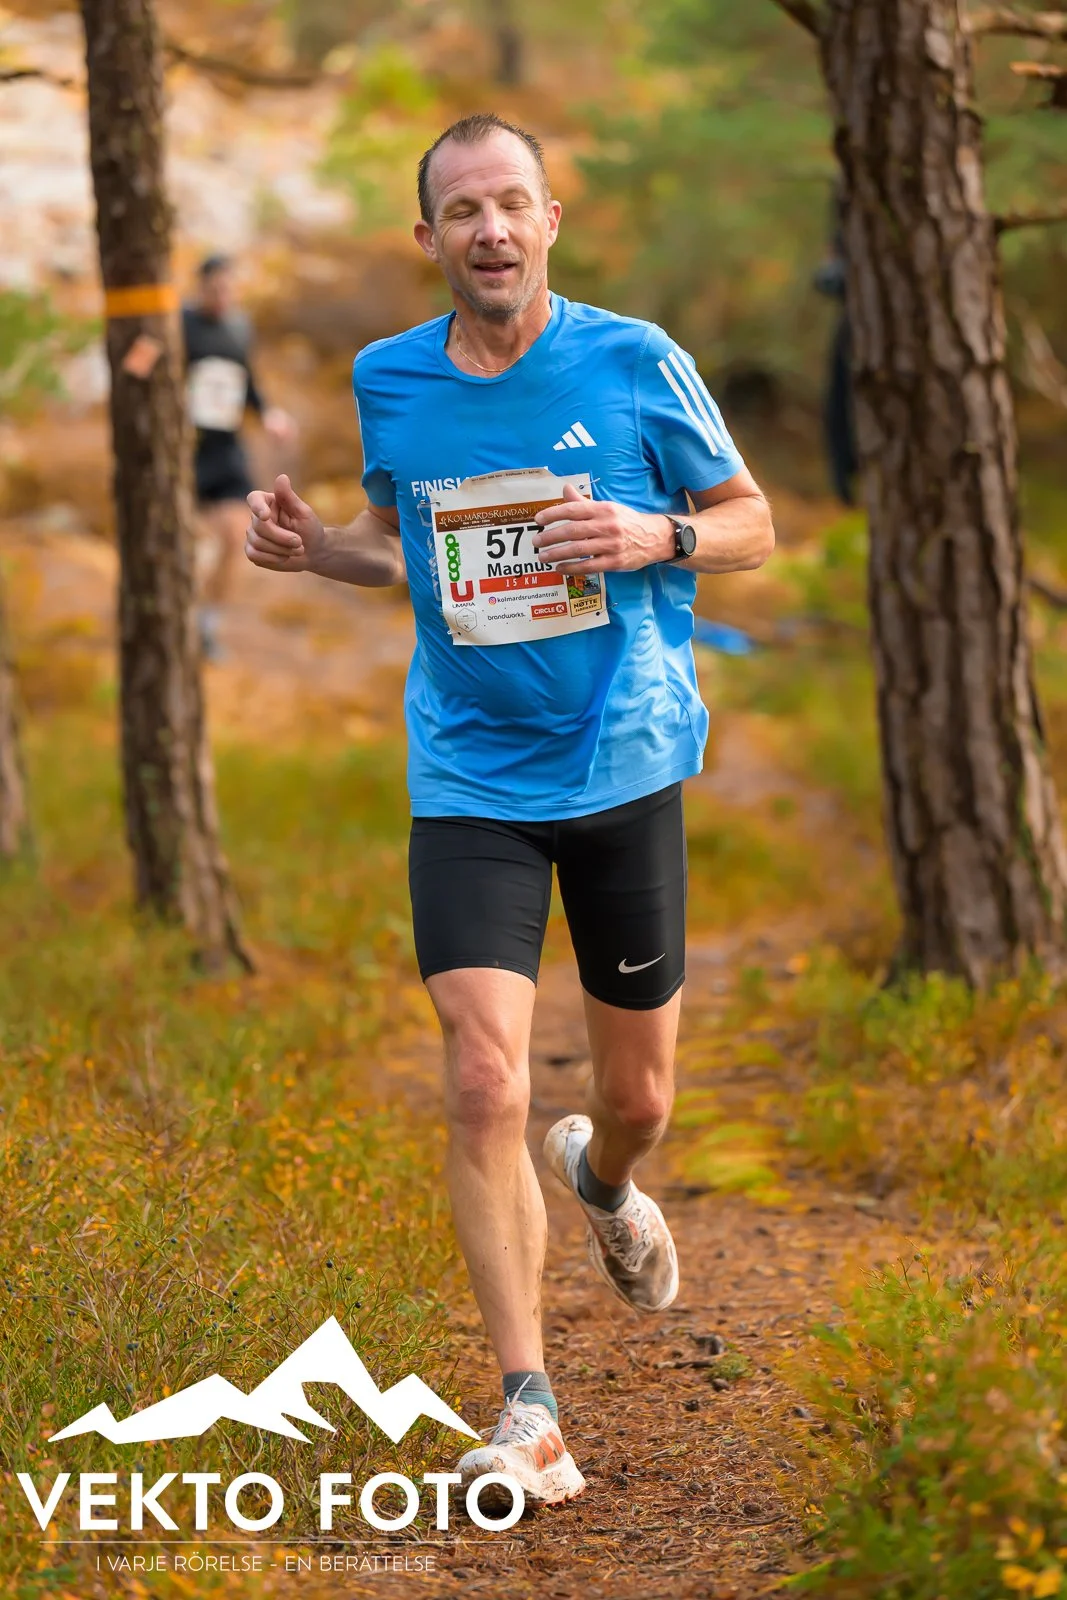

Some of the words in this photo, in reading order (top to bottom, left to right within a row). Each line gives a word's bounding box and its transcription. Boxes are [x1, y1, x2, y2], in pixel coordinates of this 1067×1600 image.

[486, 525, 544, 559] 577
[445, 533, 460, 582] coop
[487, 562, 553, 578] Magnus
[505, 578, 518, 587] 15
[524, 576, 538, 585] KM
[497, 591, 559, 603] kolmardsrundantrail
